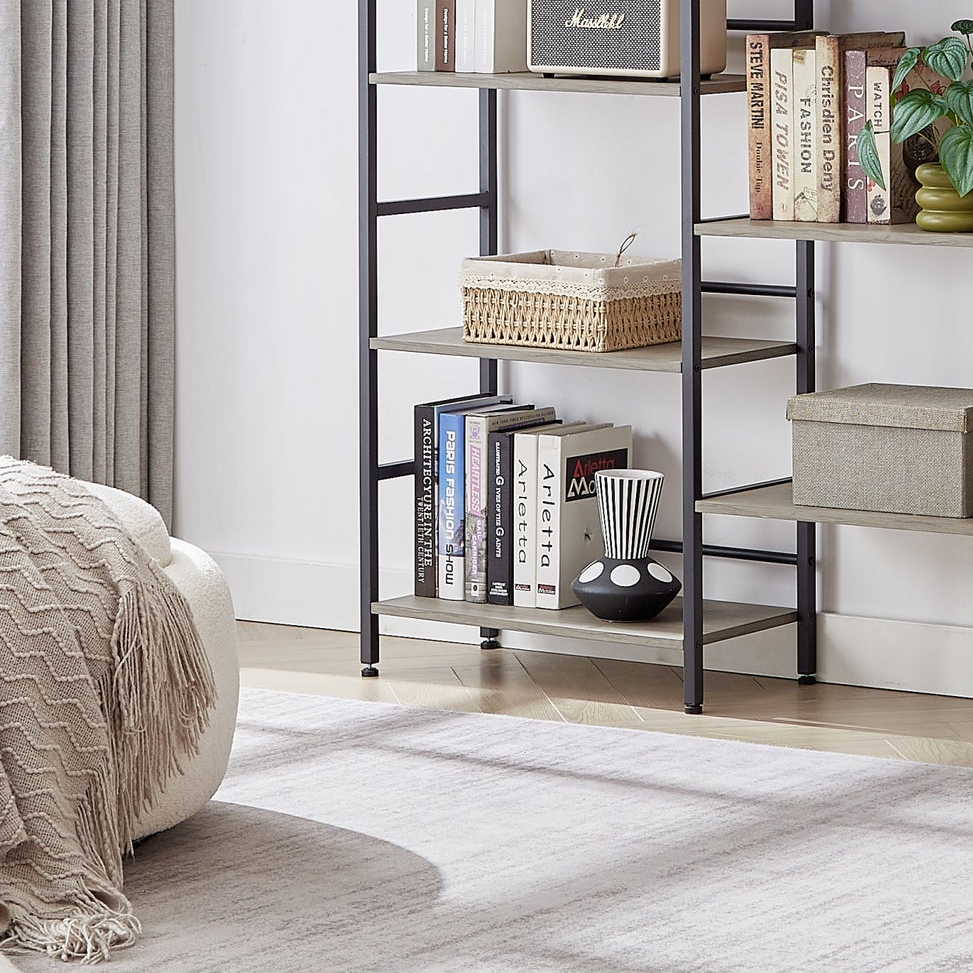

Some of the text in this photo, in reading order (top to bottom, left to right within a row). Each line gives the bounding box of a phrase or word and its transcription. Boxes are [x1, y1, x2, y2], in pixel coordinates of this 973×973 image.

[750, 42, 764, 129] STEVE MARTINI
[775, 69, 788, 115] PISA
[873, 82, 882, 127] WATCH
[800, 98, 812, 173] FASHION
[821, 149, 835, 192] Deny
[471, 446, 481, 513] HEARTLESS
[424, 522, 432, 536] IN
[518, 459, 528, 564] Arletta
[541, 464, 556, 567] Arletta
[424, 539, 433, 566] THE
